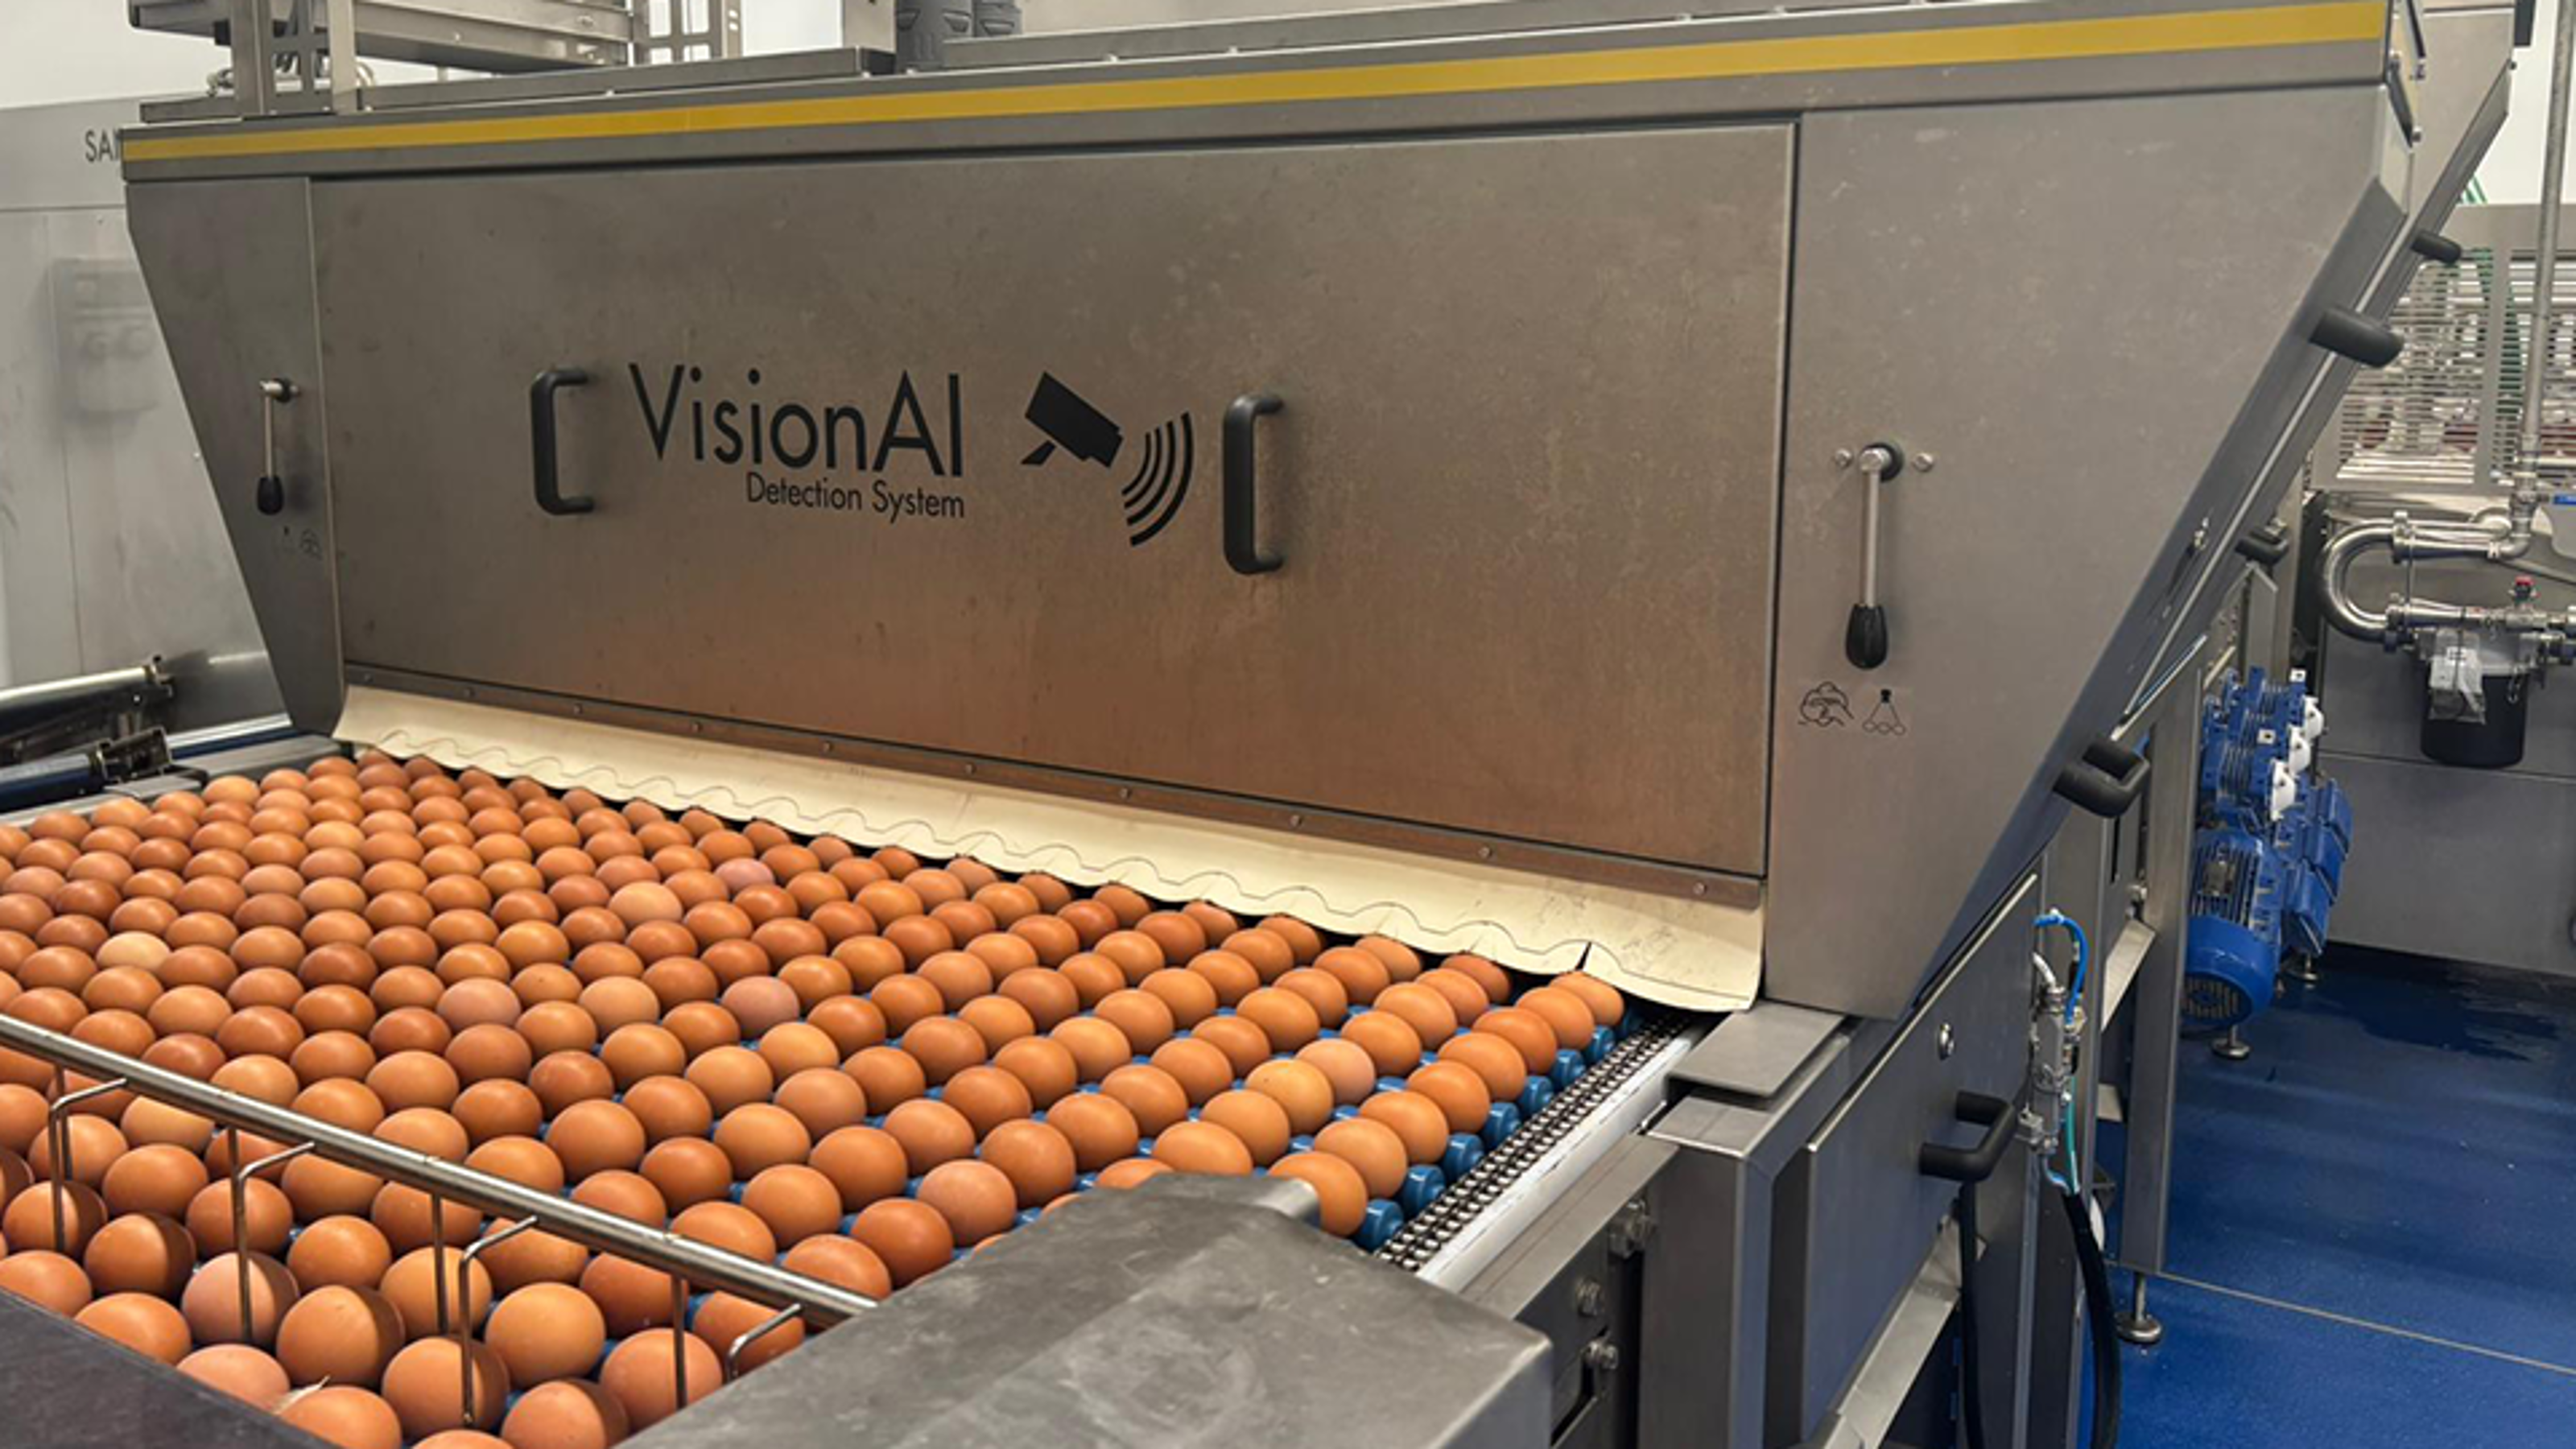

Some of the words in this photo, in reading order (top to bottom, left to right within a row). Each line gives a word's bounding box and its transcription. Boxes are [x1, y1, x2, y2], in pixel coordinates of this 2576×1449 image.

[628, 363, 963, 477] VisionAI
[747, 472, 862, 510] Detection
[872, 480, 965, 524] System
